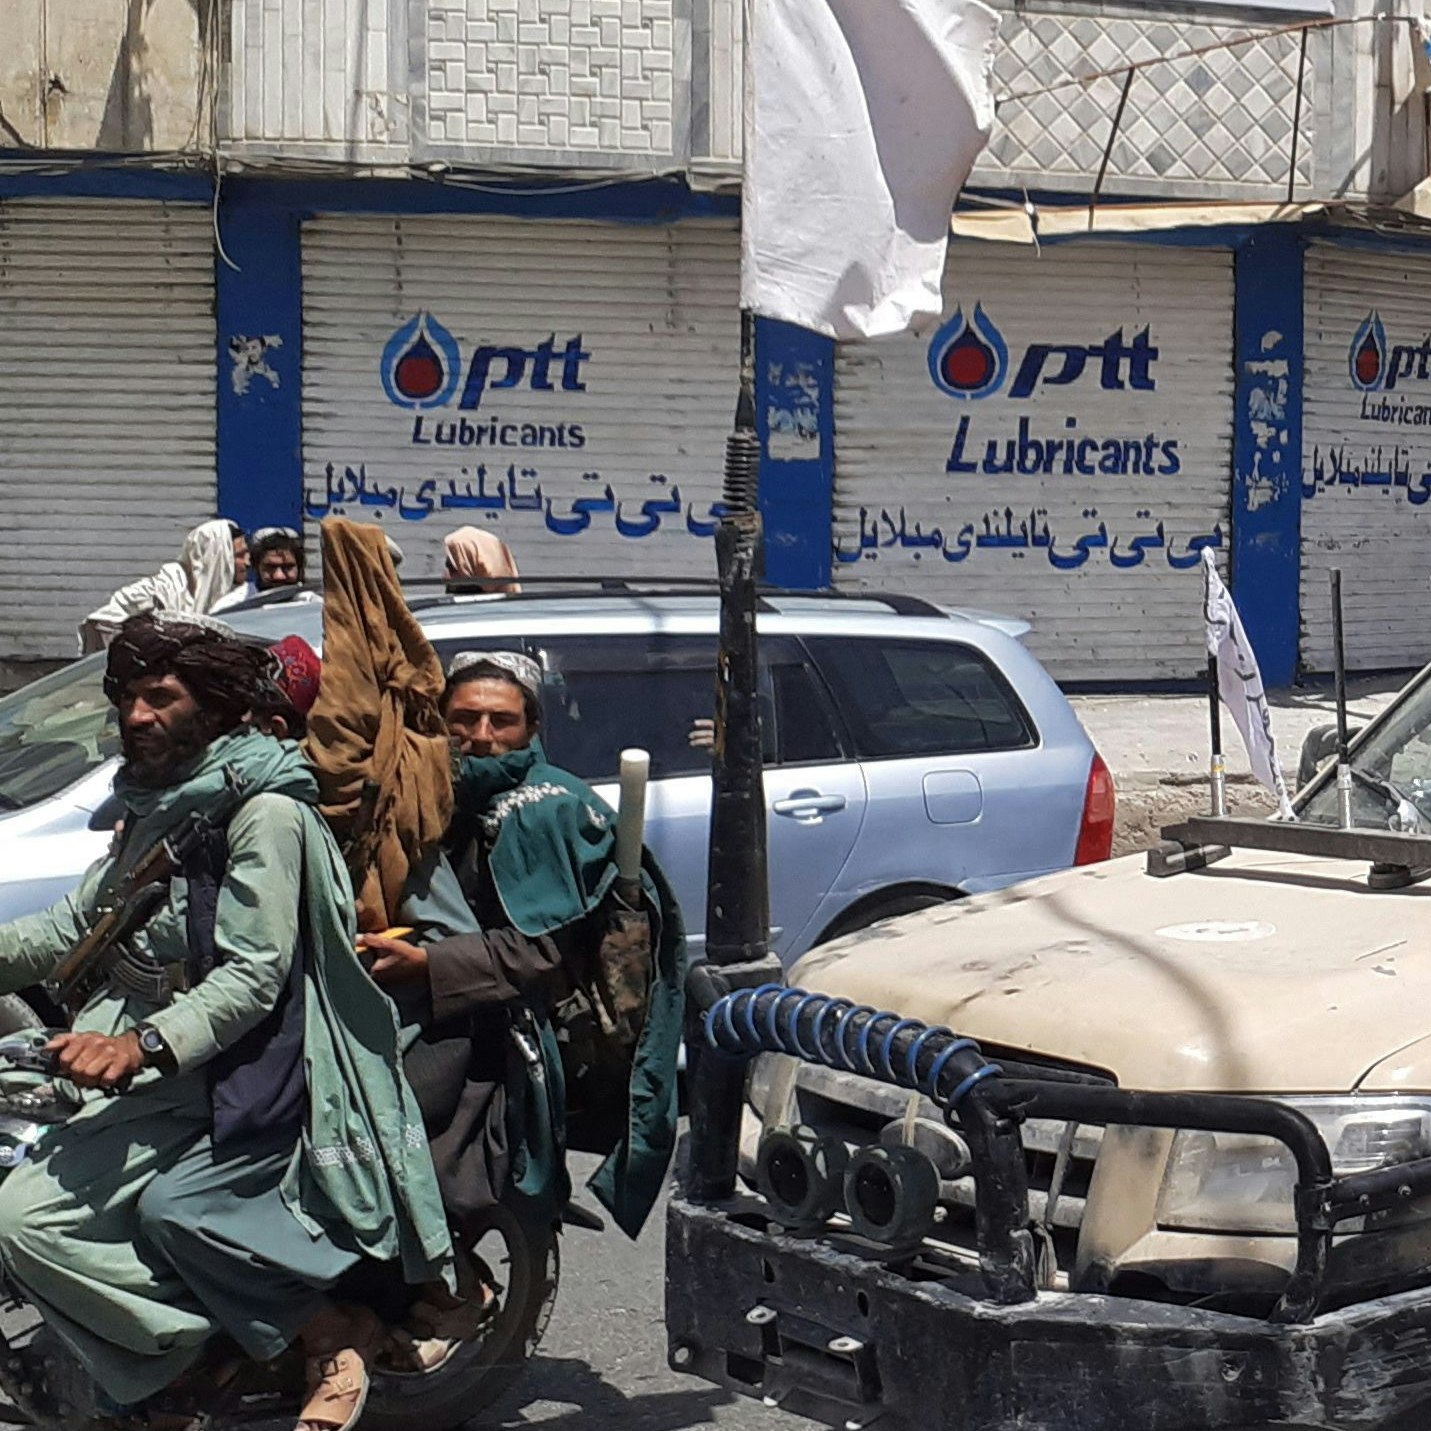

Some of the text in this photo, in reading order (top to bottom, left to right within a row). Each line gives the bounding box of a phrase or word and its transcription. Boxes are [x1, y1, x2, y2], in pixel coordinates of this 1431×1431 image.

[457, 332, 592, 410] ptt
[1007, 323, 1159, 399] ptt
[412, 416, 586, 448] Lubricants
[945, 416, 1181, 475] Lubricants
